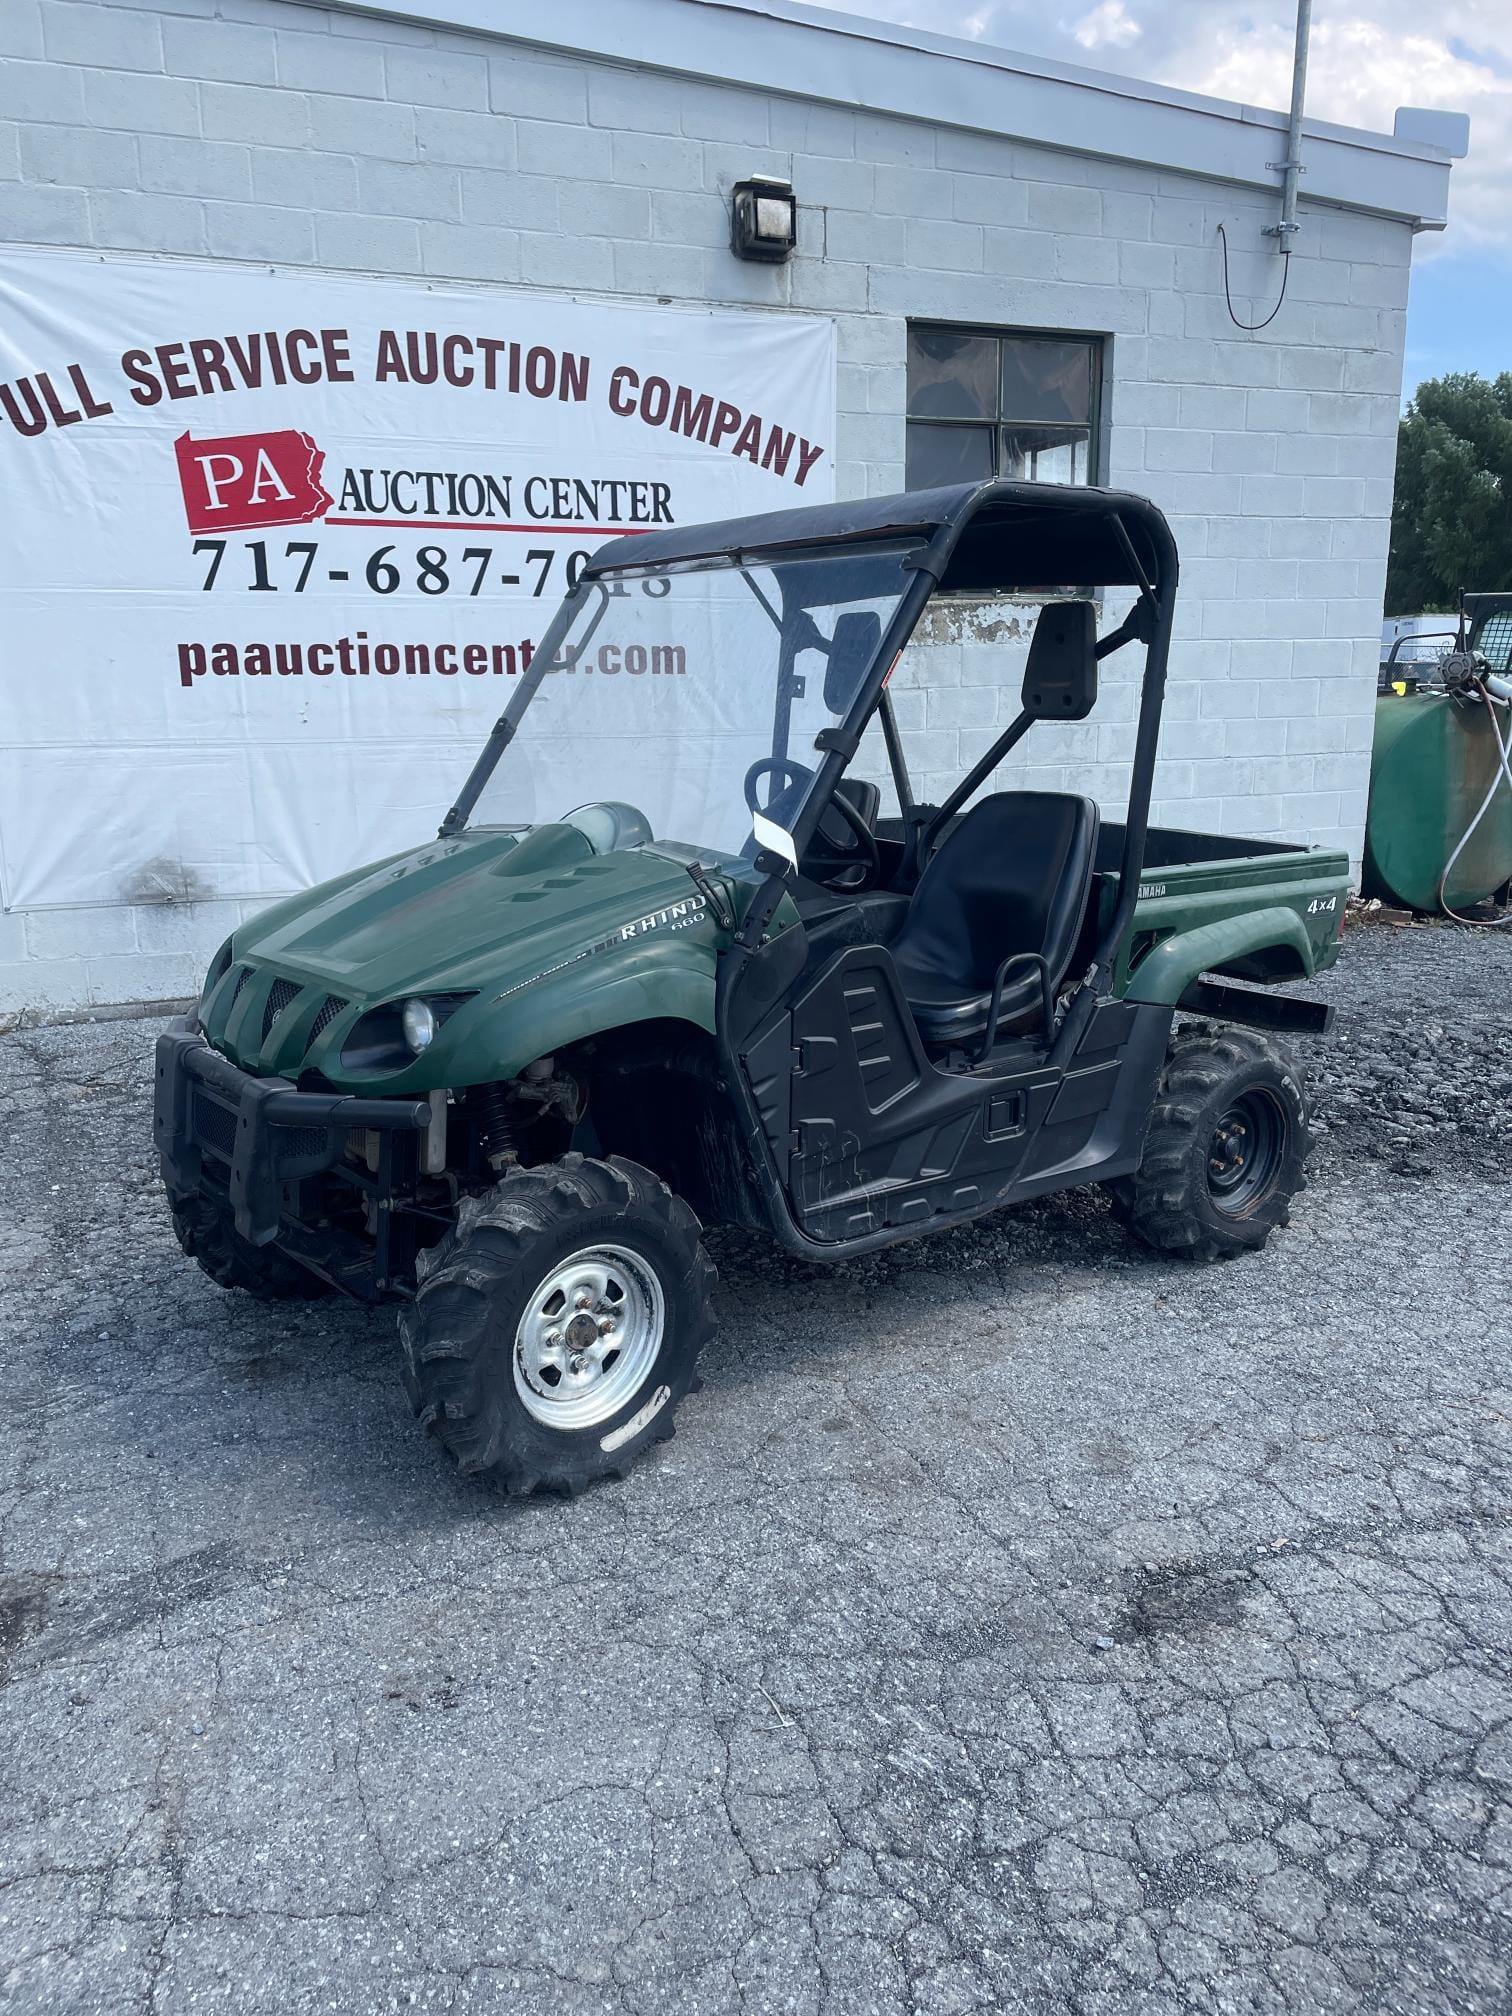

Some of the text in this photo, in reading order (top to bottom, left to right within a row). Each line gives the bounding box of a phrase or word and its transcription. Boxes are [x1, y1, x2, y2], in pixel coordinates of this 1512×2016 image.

[0, 328, 825, 487] ULL SERVICE AUCTION COMPANY
[194, 447, 675, 523] PA AUCTION CENTER
[1137, 884, 1166, 899] AMAHA
